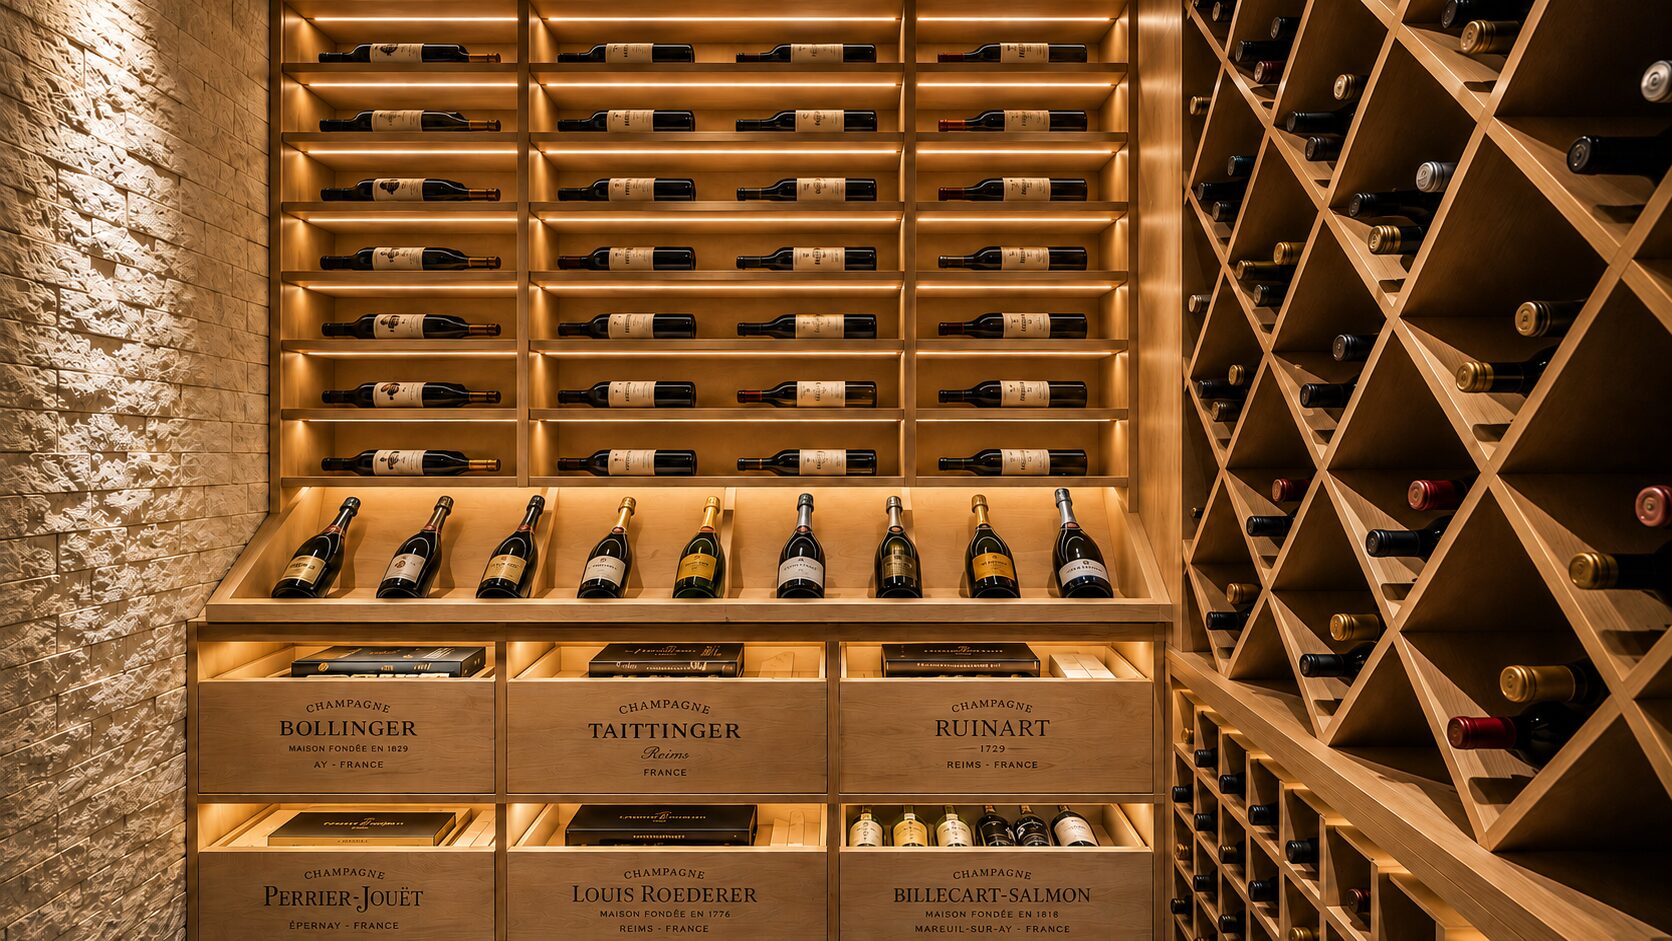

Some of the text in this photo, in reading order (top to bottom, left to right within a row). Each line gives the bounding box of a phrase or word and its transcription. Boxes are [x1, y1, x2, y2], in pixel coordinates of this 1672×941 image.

[305, 699, 392, 714] CHAMPAGNE
[618, 699, 712, 715] CHAMPAGNE
[951, 699, 1034, 714] CHAMPAGNE
[279, 720, 418, 737] BOLLINGER
[587, 722, 742, 739] TAITTINGER
[935, 719, 1051, 737] RUINART
[288, 744, 326, 753] MAISON
[371, 744, 384, 753] EN
[387, 744, 409, 753] 1829
[640, 745, 690, 760] Reims
[980, 744, 1006, 753] 1729
[313, 760, 328, 769] AY
[339, 760, 384, 769] FRANCE
[946, 760, 982, 769] REIMS
[994, 760, 1038, 769] FRANCE
[643, 768, 687, 777] FRANCE
[303, 867, 386, 880] CHAMPAGNE
[623, 867, 705, 880] CHAMPAGNE
[952, 868, 1032, 880] CHAMPAGNE
[263, 885, 424, 913] PERRIER-JOUËT
[572, 884, 758, 903] LOUIS ROEDERER
[893, 887, 1091, 903] BILLECART-SALMON
[599, 910, 640, 918] MAISON
[690, 910, 704, 918] EN
[708, 910, 731, 918] 1776
[925, 910, 967, 919] MAISON
[971, 909, 1014, 919] FONDÉE
[1018, 910, 1032, 919] EN
[288, 919, 341, 930] ÉPERNAY
[353, 921, 399, 930] FRANCE
[619, 924, 654, 933] REIMS
[665, 924, 709, 933] FRANCE
[914, 925, 1012, 934] MAREUIL-SUR-AY
[1025, 925, 1070, 934] FRANCE
